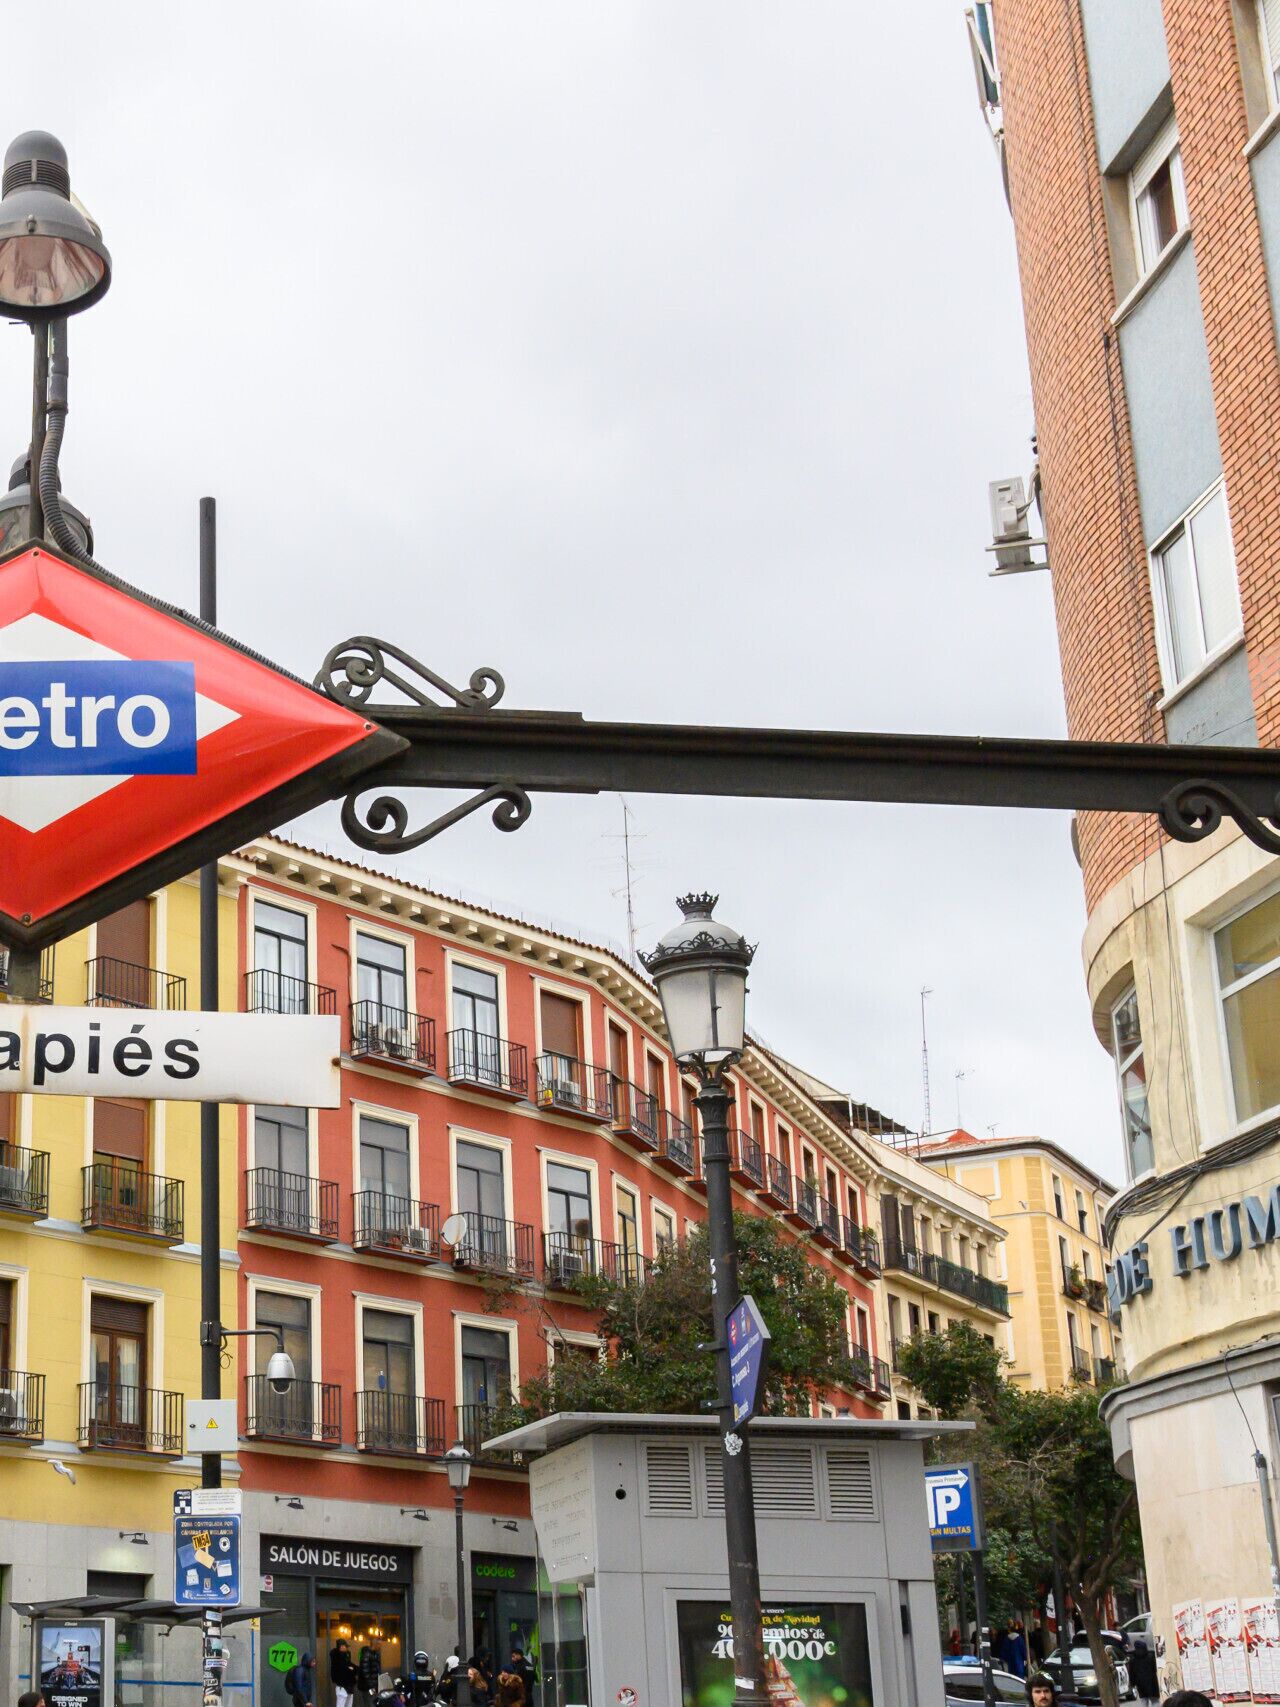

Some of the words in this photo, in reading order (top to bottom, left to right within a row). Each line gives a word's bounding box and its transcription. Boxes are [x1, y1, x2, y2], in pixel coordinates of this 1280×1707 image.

[1115, 1242, 1153, 1305] DE
[935, 1487, 960, 1525] P
[944, 1526, 971, 1535] MULTAS
[270, 1544, 319, 1565] SALÓN
[322, 1550, 341, 1567] DE
[343, 1552, 398, 1572] JUEGOS
[476, 1563, 516, 1578] codere
[773, 1614, 783, 1622] de
[784, 1615, 820, 1625] Navidad
[809, 1627, 825, 1640] de
[272, 1650, 295, 1664] 777
